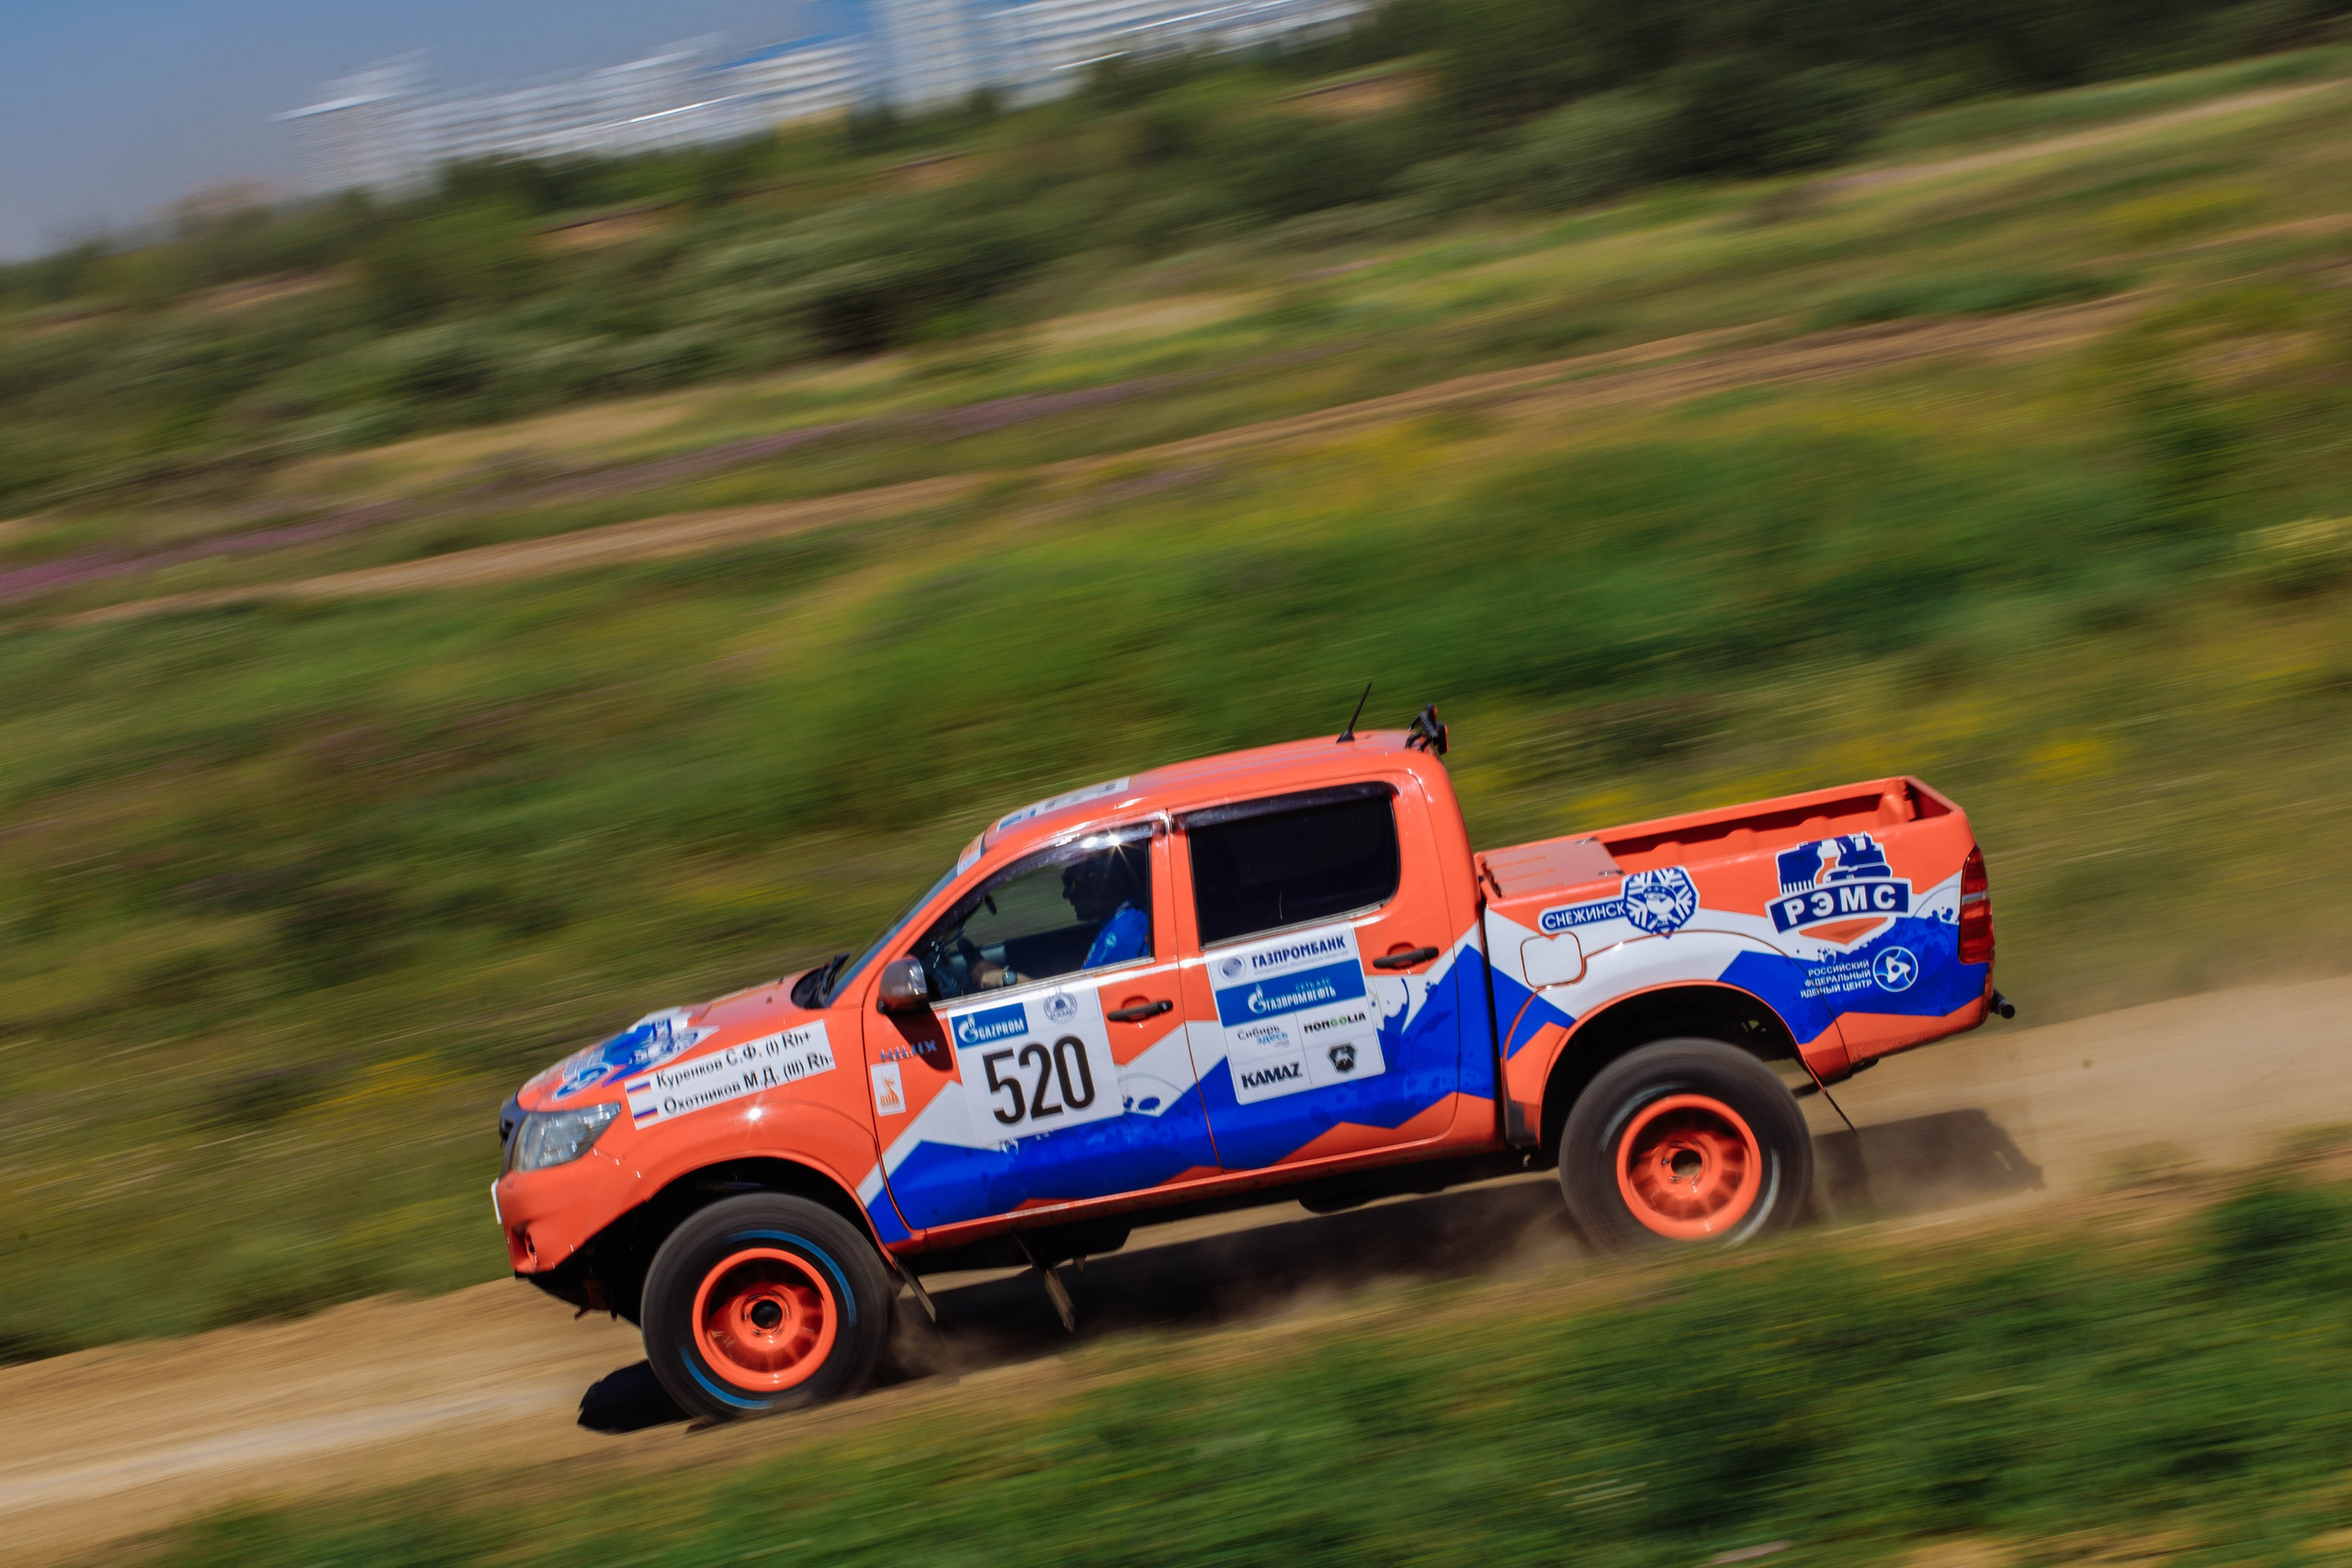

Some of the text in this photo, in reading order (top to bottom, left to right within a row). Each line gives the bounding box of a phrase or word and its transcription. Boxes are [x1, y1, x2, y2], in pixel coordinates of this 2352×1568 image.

[1544, 901, 1626, 929] СНЕЖИНСК
[1783, 884, 1896, 926] РЭМС
[1251, 936, 1346, 969] ГАЗПРОМБАНК
[1808, 960, 1870, 977] РОССИЙСКИЙ
[1267, 985, 1336, 1011] ГАЗПРОМНЕФТЬ
[1842, 979, 1872, 992] ЦЕНТР
[978, 1018, 1025, 1041] GAZPROM
[1238, 1024, 1280, 1041] Сибирь
[656, 1060, 723, 1089] Куренков
[726, 1043, 763, 1067] С.Ф.
[782, 1030, 811, 1051] Rh+
[982, 1034, 1096, 1124] 520
[1240, 1061, 1303, 1090] KAMAZ
[663, 1079, 741, 1114] Охотников
[742, 1066, 781, 1089] М.Д.
